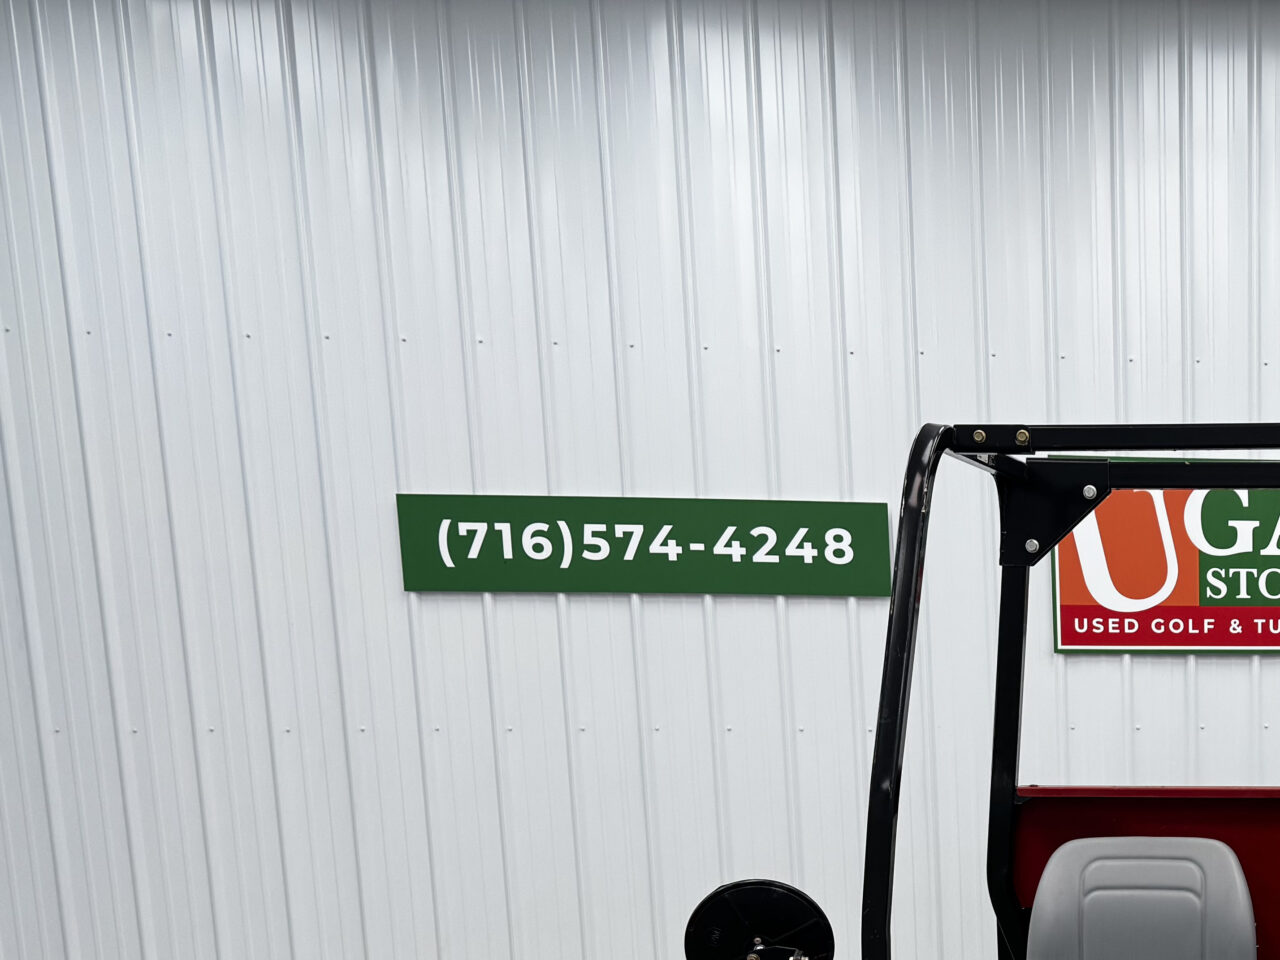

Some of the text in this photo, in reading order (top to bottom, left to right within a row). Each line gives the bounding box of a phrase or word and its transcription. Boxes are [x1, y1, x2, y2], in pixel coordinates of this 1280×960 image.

[438, 519, 855, 570] (716)574-4248
[1074, 617, 1140, 634] USED
[1150, 617, 1216, 635] GOLF
[1229, 618, 1243, 634] &
